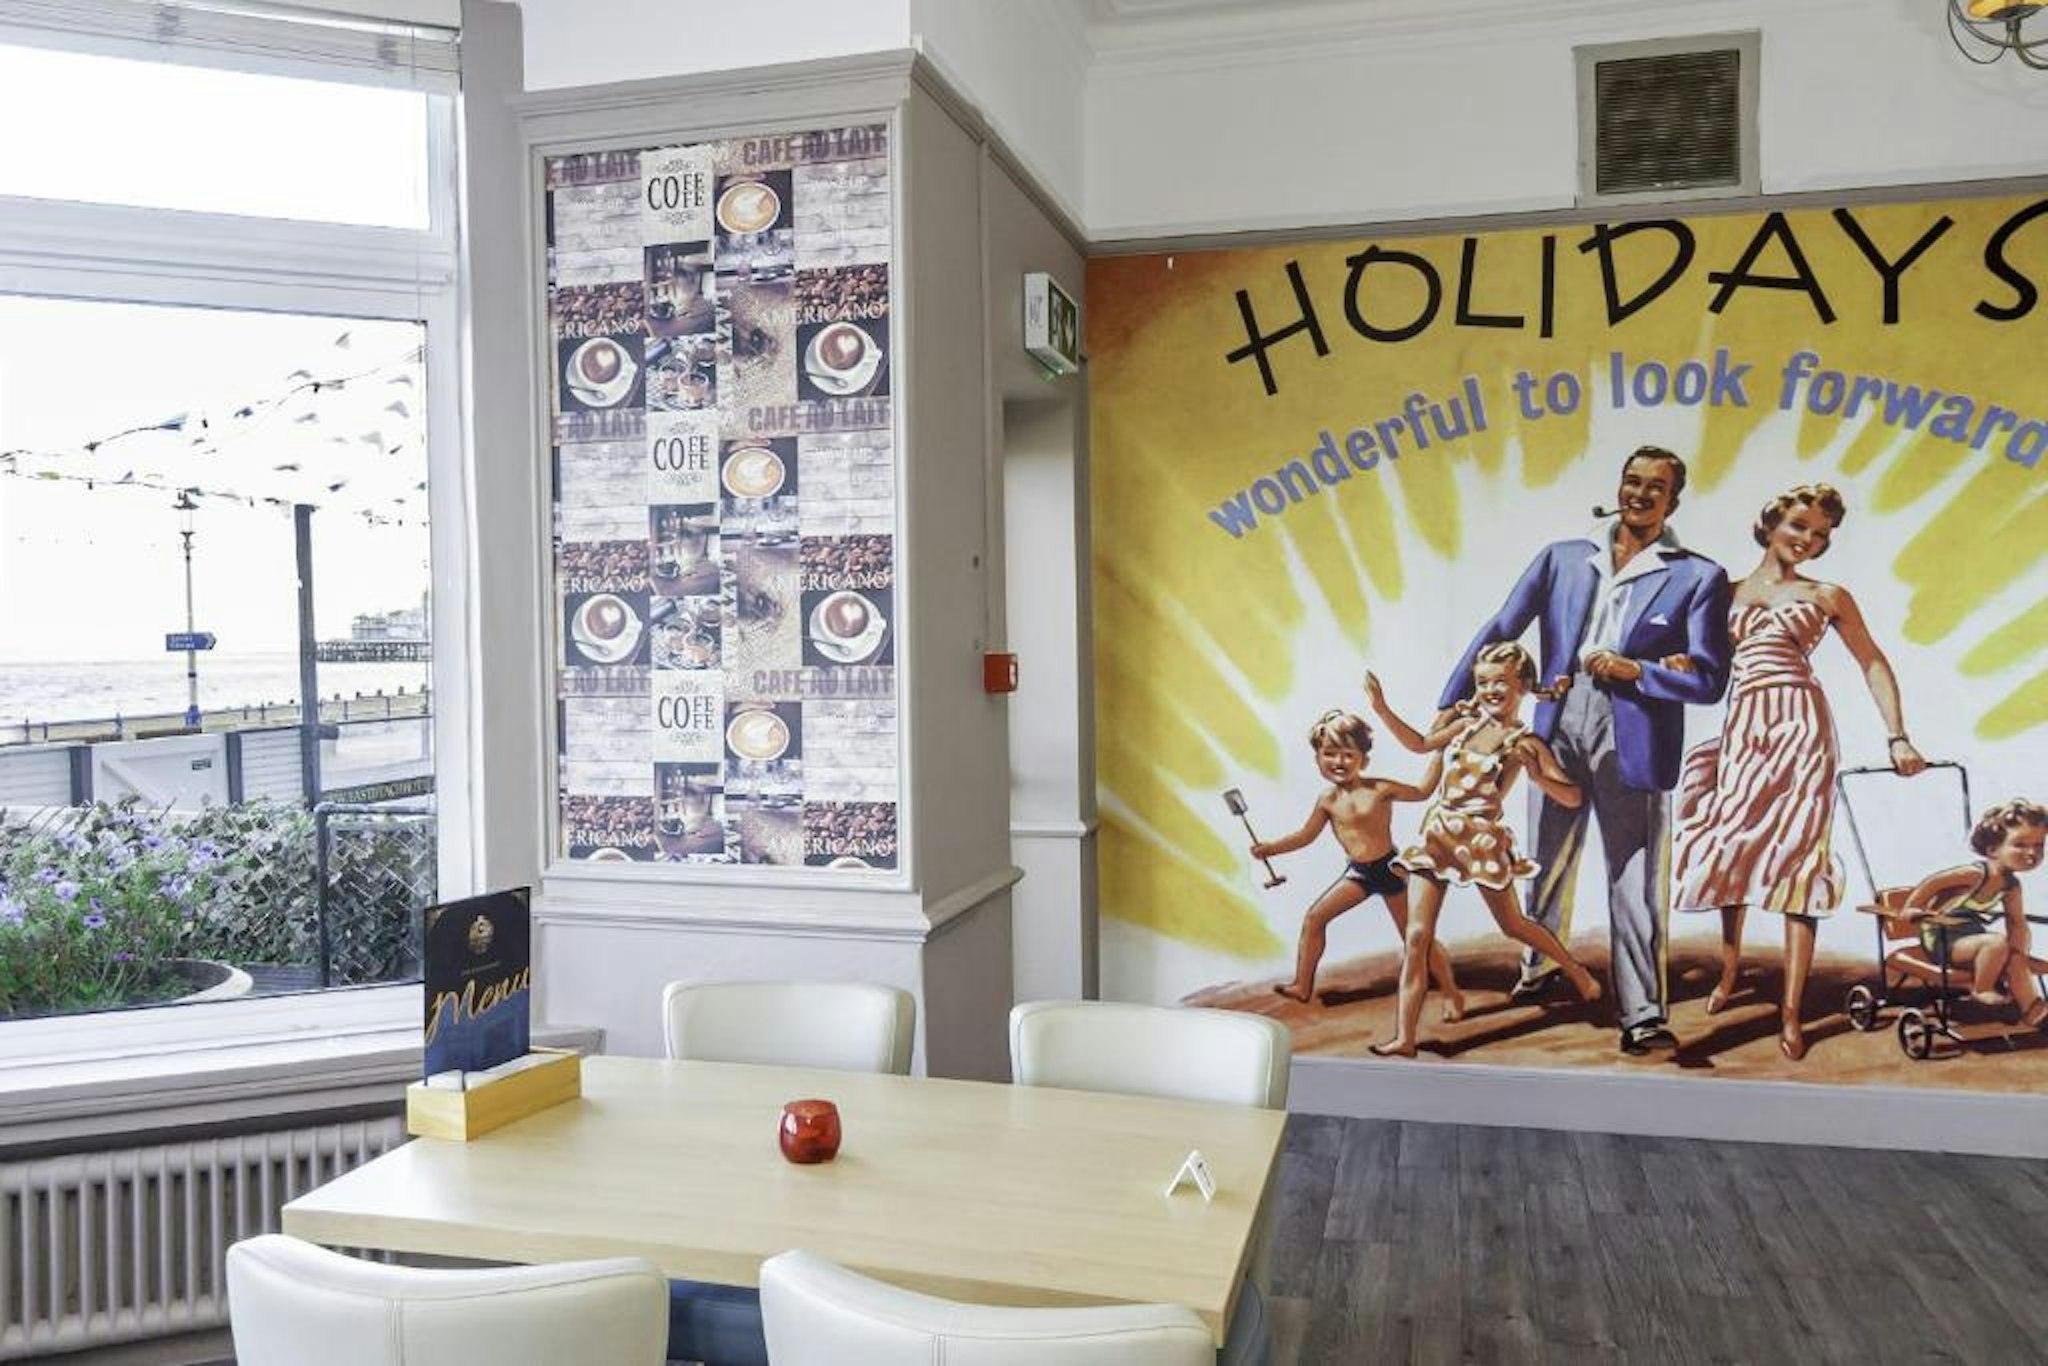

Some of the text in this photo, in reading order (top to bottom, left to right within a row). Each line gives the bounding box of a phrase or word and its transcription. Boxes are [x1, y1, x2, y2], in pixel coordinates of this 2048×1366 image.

[743, 138, 796, 166] CAFE
[1225, 198, 2048, 397] HOLIDAYS
[750, 405, 800, 431] CAFE
[1207, 349, 2048, 540] wonderful to look forward
[753, 669, 803, 694] CAFE
[425, 966, 529, 1045] Menu
